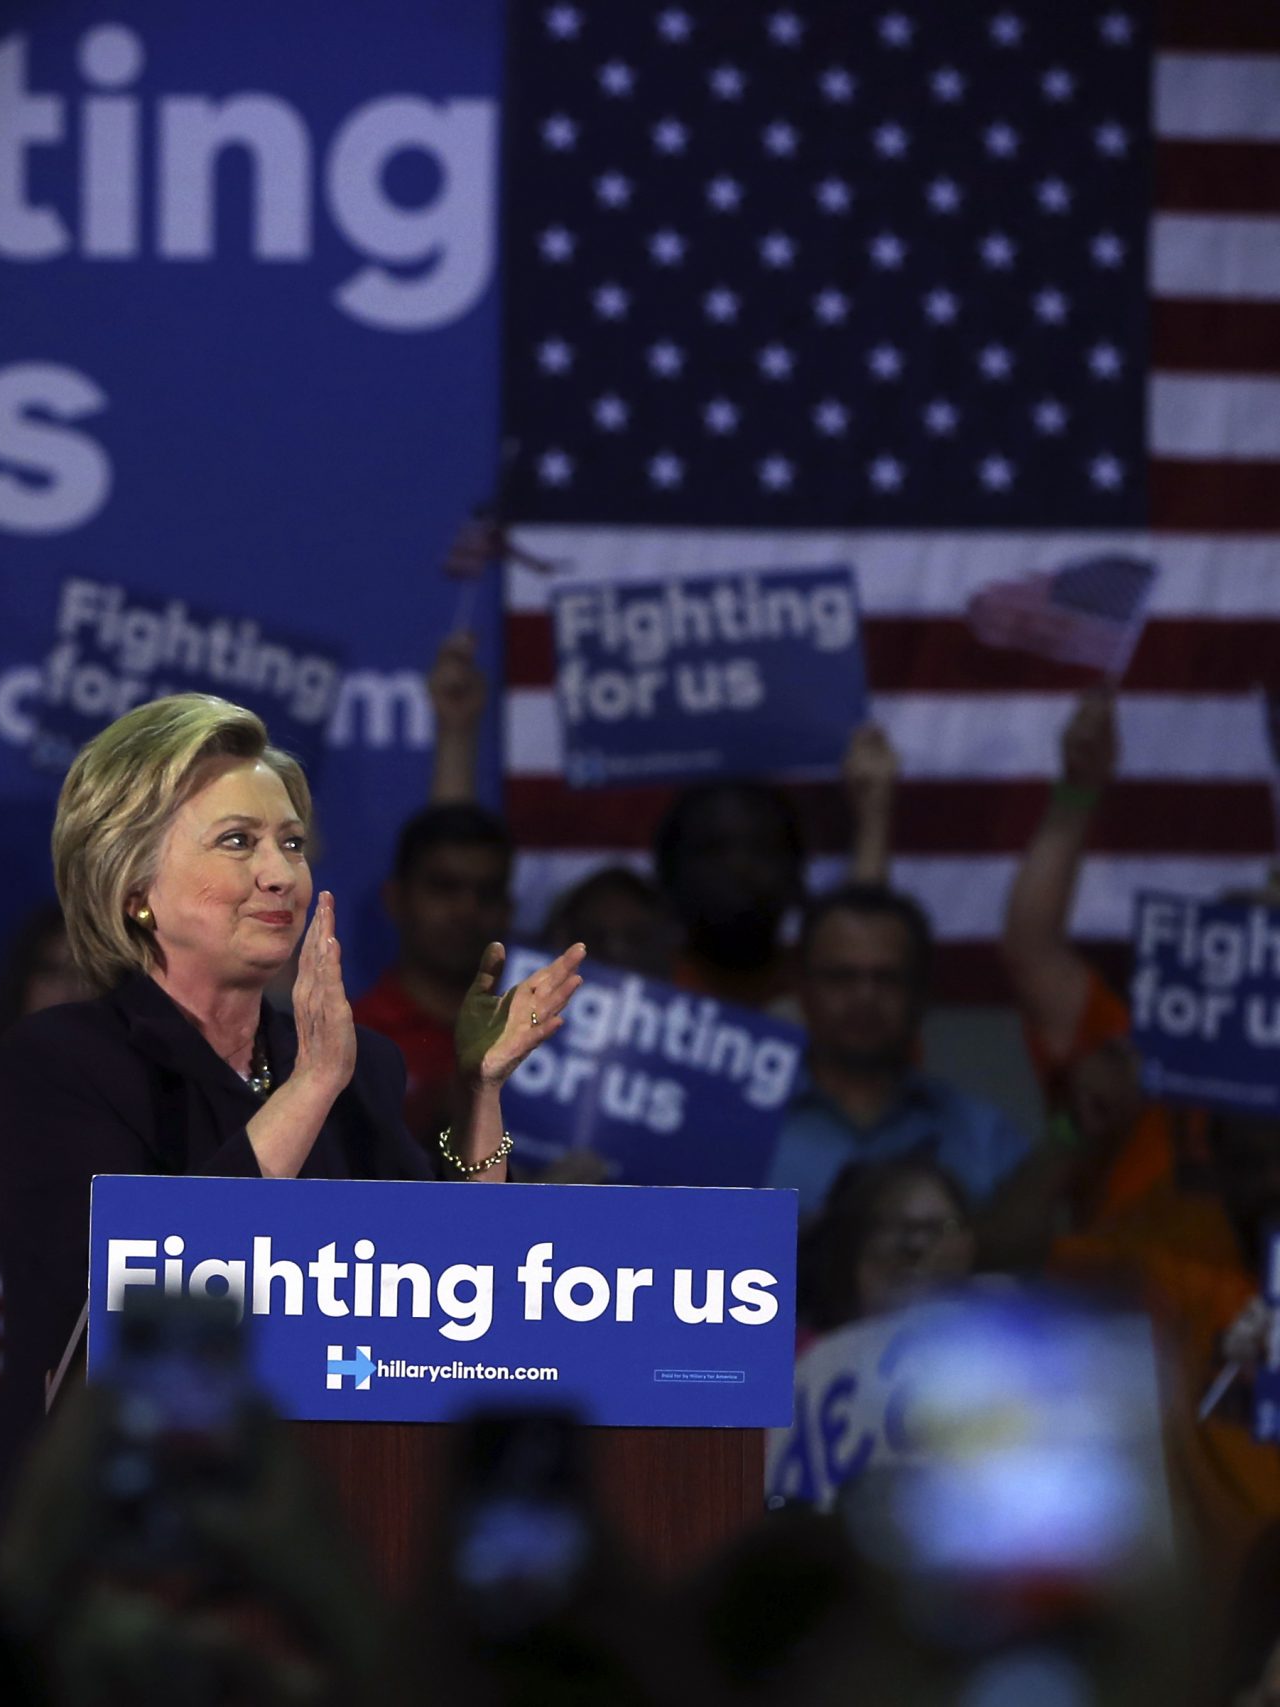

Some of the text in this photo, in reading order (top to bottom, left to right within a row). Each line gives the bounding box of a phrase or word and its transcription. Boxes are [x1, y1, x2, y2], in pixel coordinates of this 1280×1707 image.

[58, 577, 337, 724] Fighting
[558, 575, 855, 665] Fighting
[560, 654, 766, 723] for us
[1131, 964, 1235, 1041] for
[511, 1044, 687, 1135] or us
[517, 1242, 654, 1323] for
[672, 1266, 780, 1327] us
[376, 1359, 558, 1383] hillaryclinton.com
